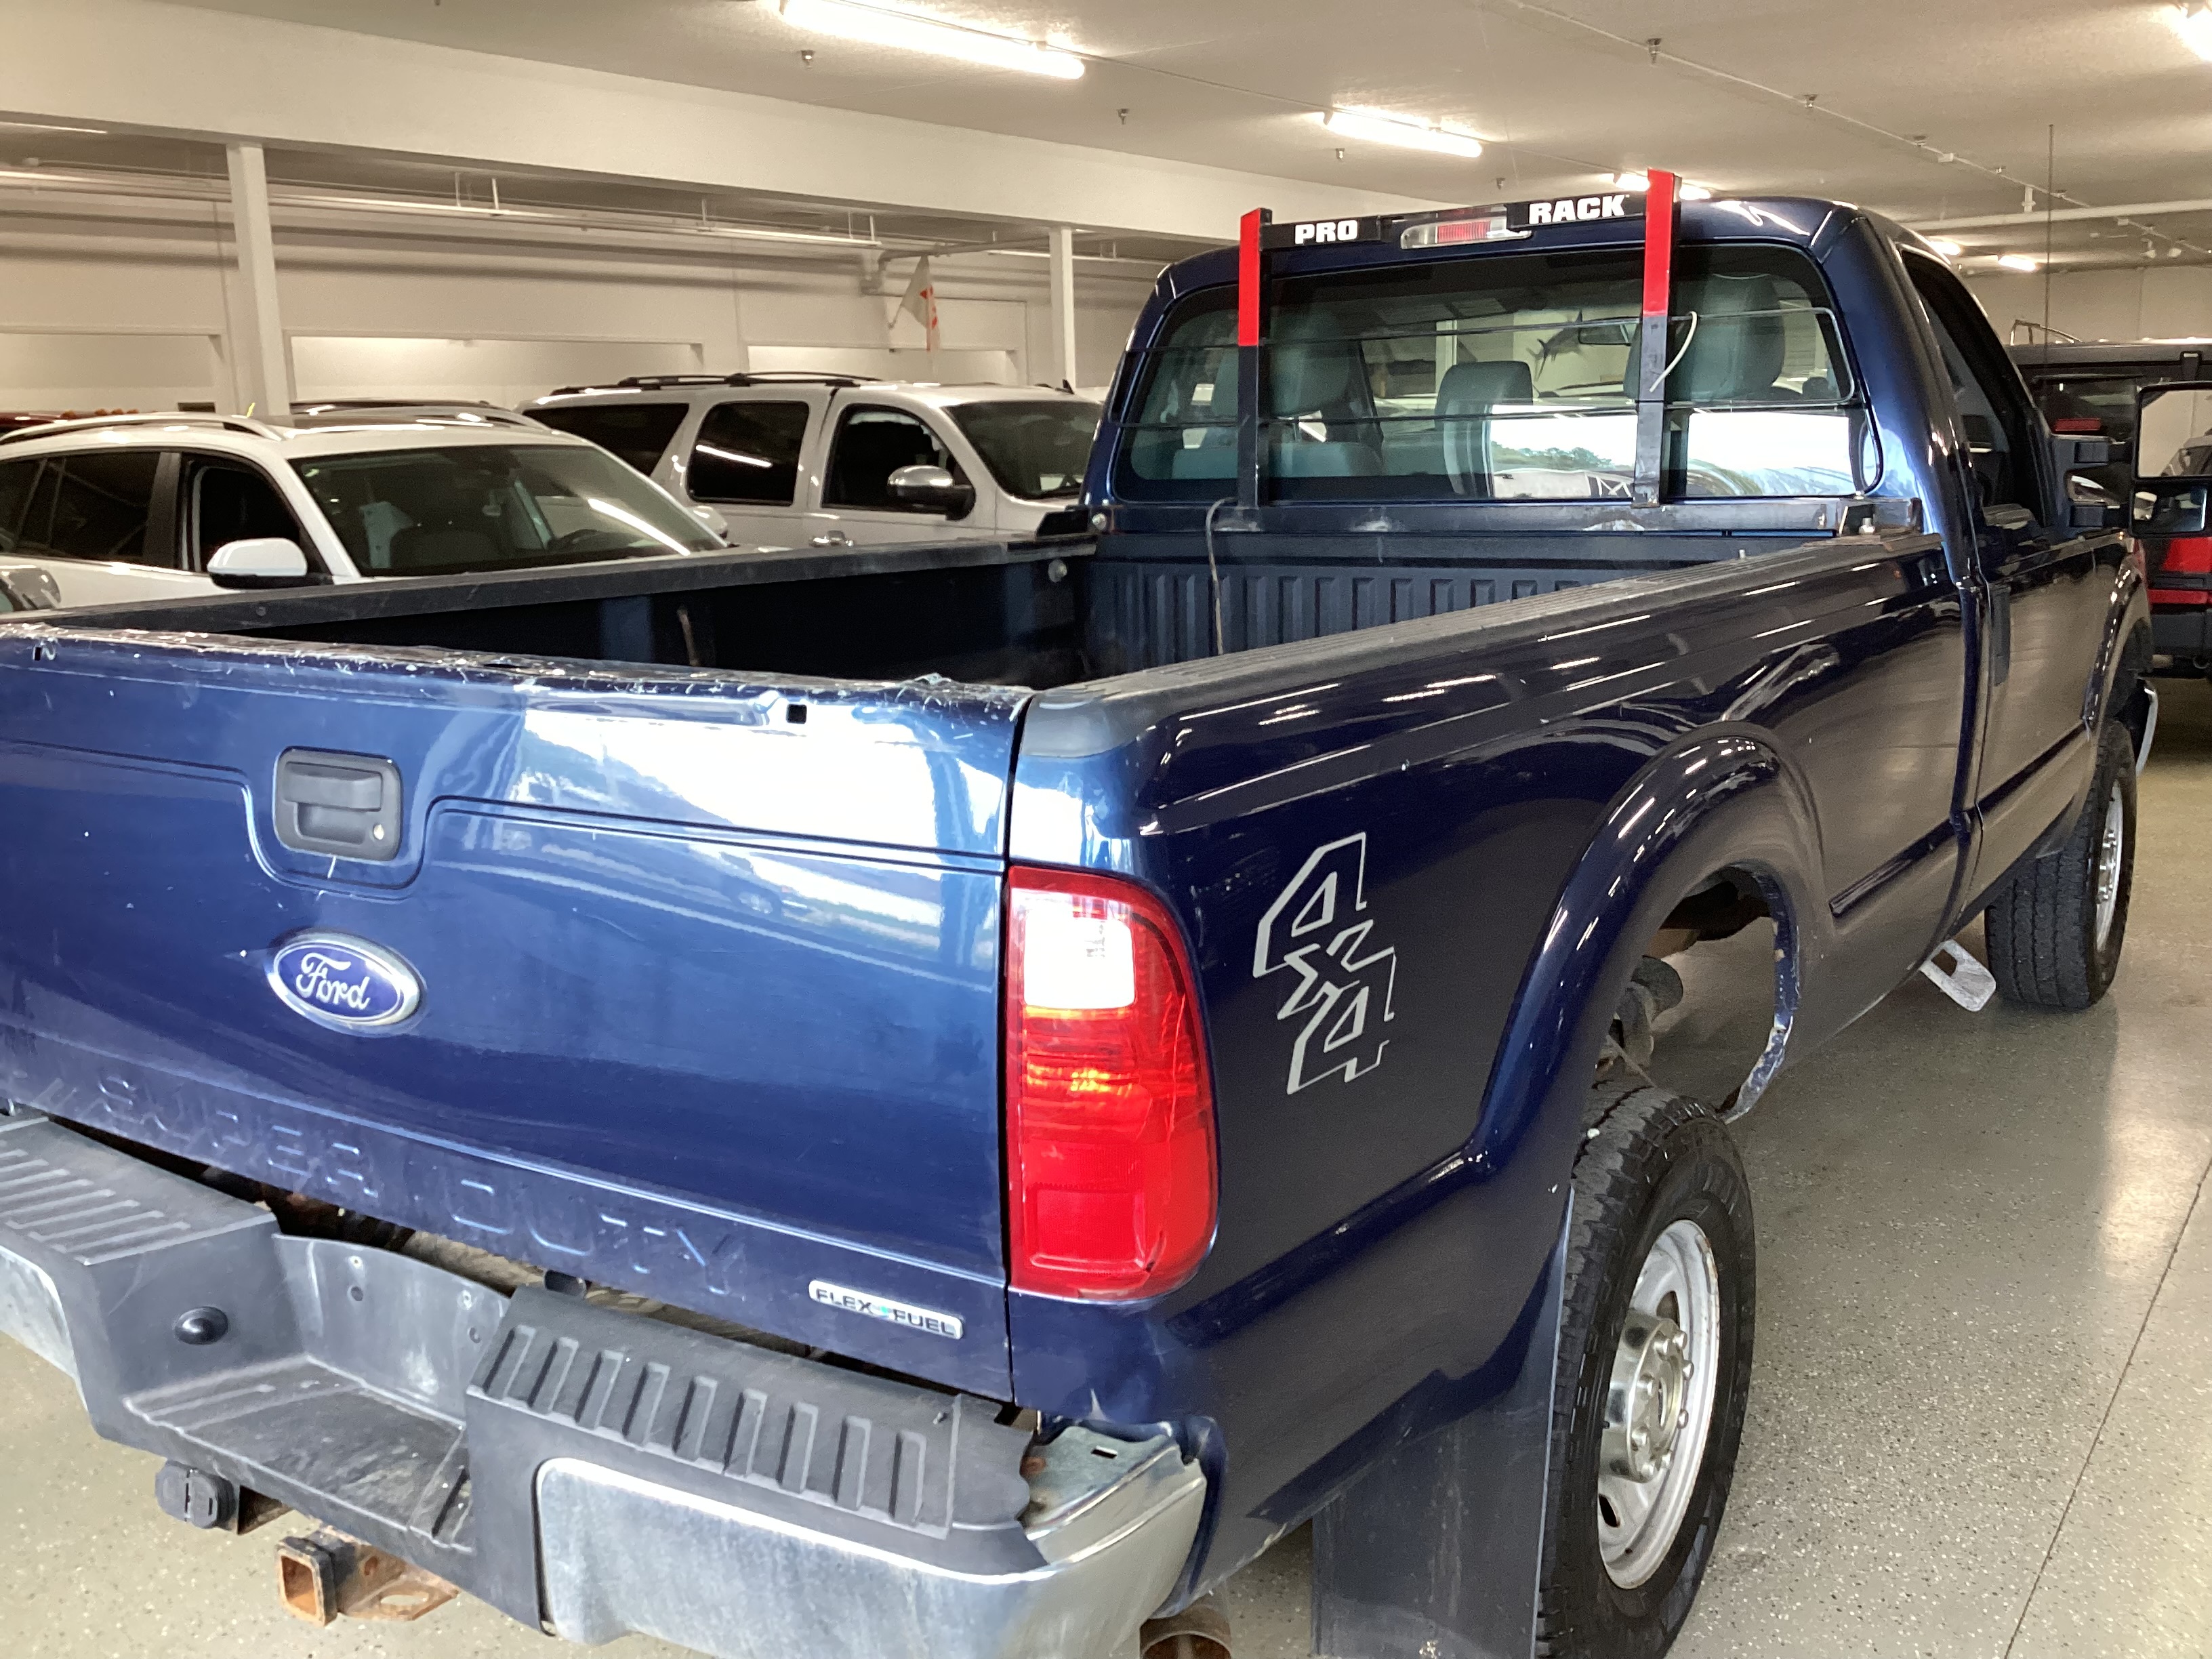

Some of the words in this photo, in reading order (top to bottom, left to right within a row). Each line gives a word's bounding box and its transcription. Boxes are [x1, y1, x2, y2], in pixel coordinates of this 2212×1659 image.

[1294, 220, 1358, 244] PRO
[1528, 194, 1625, 225] RACK
[295, 953, 370, 1010] Ford
[816, 1288, 872, 1314] FLEX
[893, 1309, 954, 1336] FUEL
